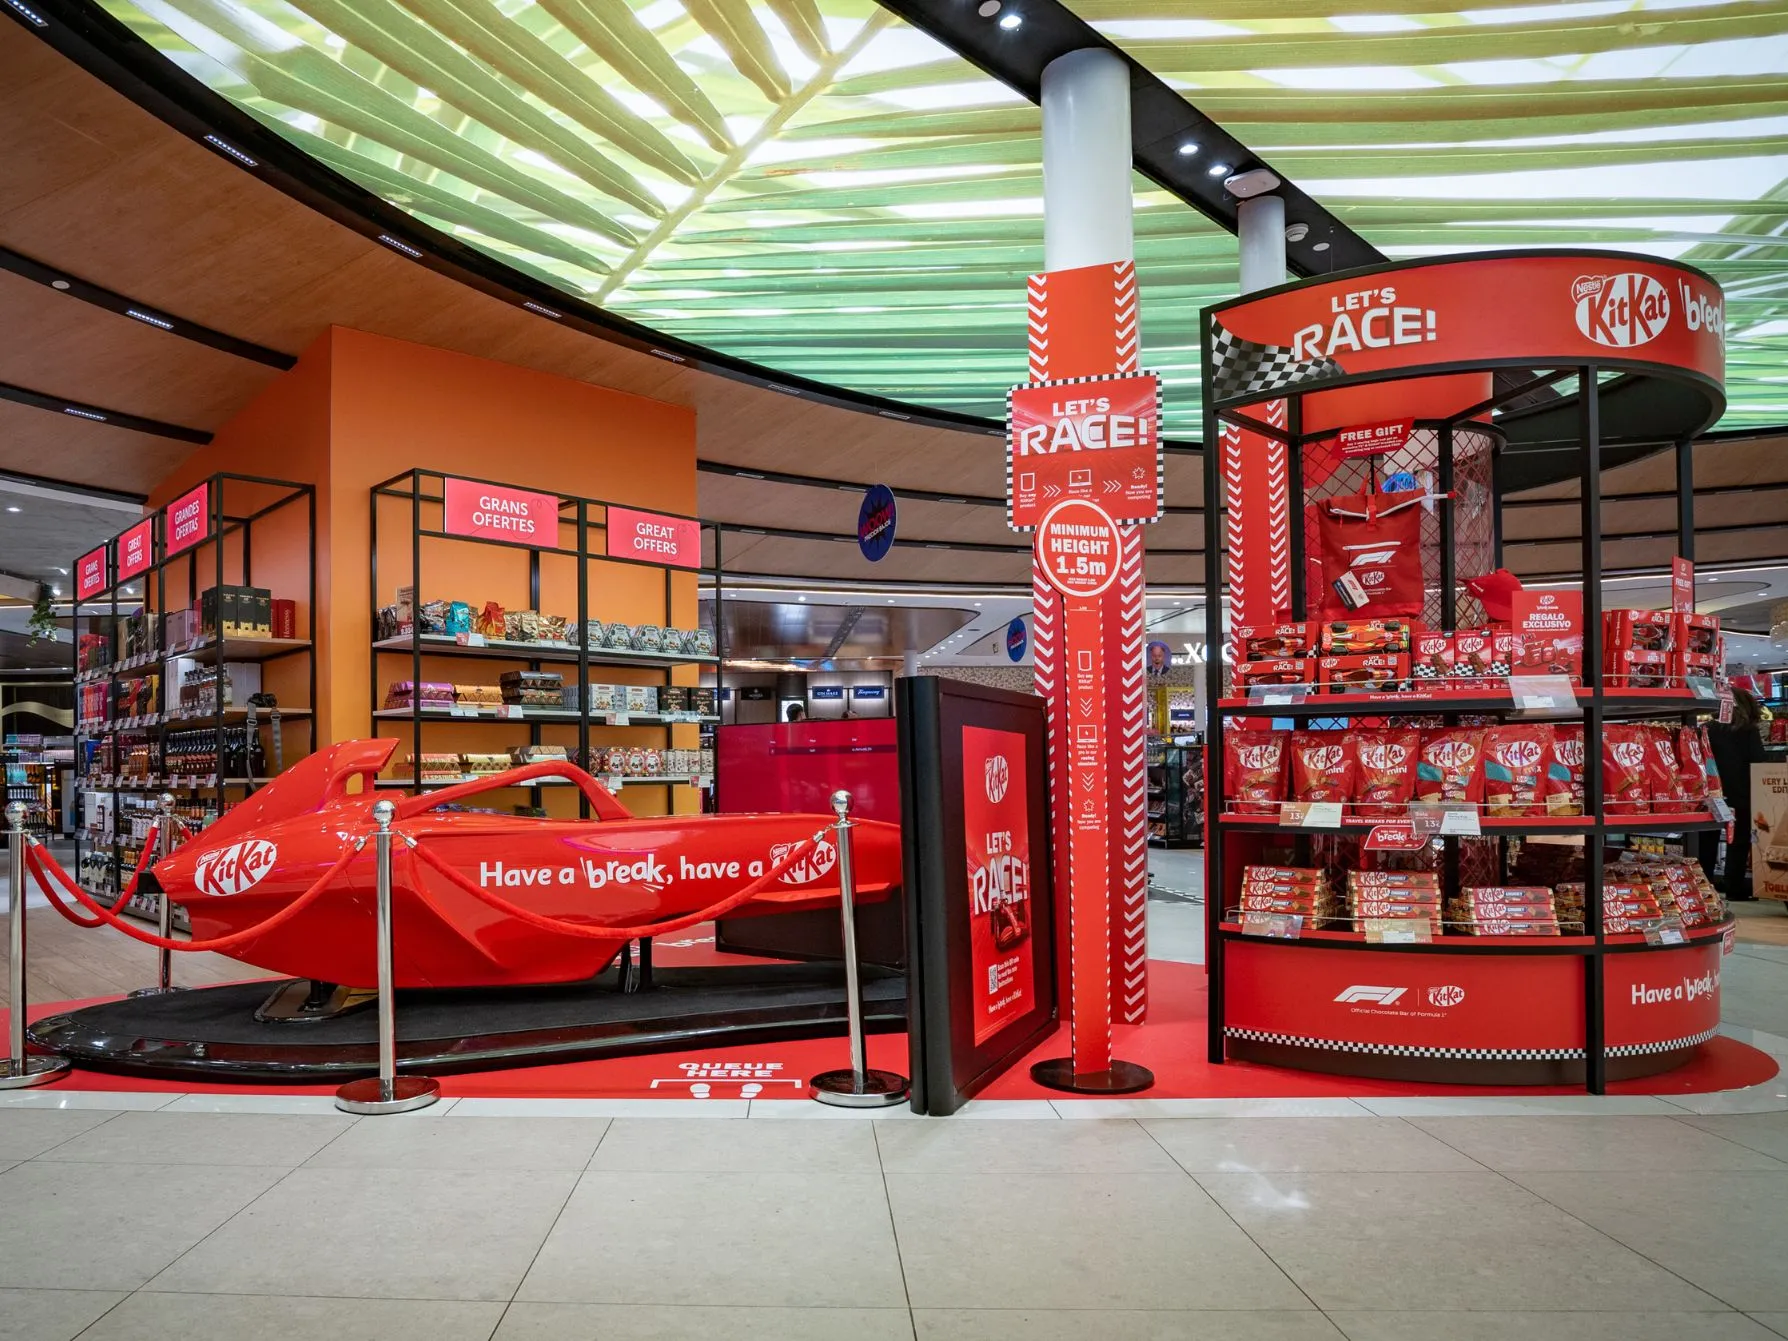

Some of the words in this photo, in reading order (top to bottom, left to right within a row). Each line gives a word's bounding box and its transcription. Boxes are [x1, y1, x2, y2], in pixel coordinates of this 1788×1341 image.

[1331, 287, 1396, 313] LET'S
[1588, 274, 1667, 345] KitKat
[1294, 307, 1436, 361] RACE!
[1053, 397, 1110, 416] LET'S
[1020, 414, 1148, 456] RACE!
[1340, 429, 1372, 442] FREE
[1375, 424, 1403, 437] GIFT
[174, 500, 200, 525] GRANDES
[479, 496, 529, 517] GRANS
[175, 518, 199, 541] OFERTAS
[472, 512, 535, 533] OFERTES
[636, 523, 675, 539] GREAT
[1050, 523, 1109, 538] MINIMUM
[127, 535, 142, 552] GREAT
[633, 537, 677, 555] OFFERS
[1051, 538, 1109, 555] HEIGHT
[1056, 556, 1106, 575] 1.5m
[1523, 620, 1571, 628] EXCLUSIVO
[1530, 613, 1564, 621] REGALO
[1244, 745, 1278, 768] KitKat
[1308, 745, 1340, 769] KitKat
[1366, 744, 1403, 769] KitKat
[1433, 742, 1473, 767] KitKat
[1501, 741, 1540, 767] KitKat
[1559, 741, 1584, 765] KitKa
[988, 757, 1007, 802] KitKat
[1263, 765, 1280, 774] mini
[1325, 766, 1344, 775] mini
[1387, 765, 1407, 775] mini
[986, 831, 1012, 854] LET'S
[203, 841, 274, 895] KitKat
[480, 861, 551, 887] Have
[559, 865, 575, 885] a
[584, 854, 673, 890] break,
[680, 856, 737, 880] have
[748, 860, 763, 878] a
[973, 855, 1028, 916] RACE!
[1434, 986, 1463, 1005] KitKat
[1631, 983, 1671, 1005] Have
[1674, 985, 1682, 1000] a
[678, 1063, 784, 1071] QUEUE
